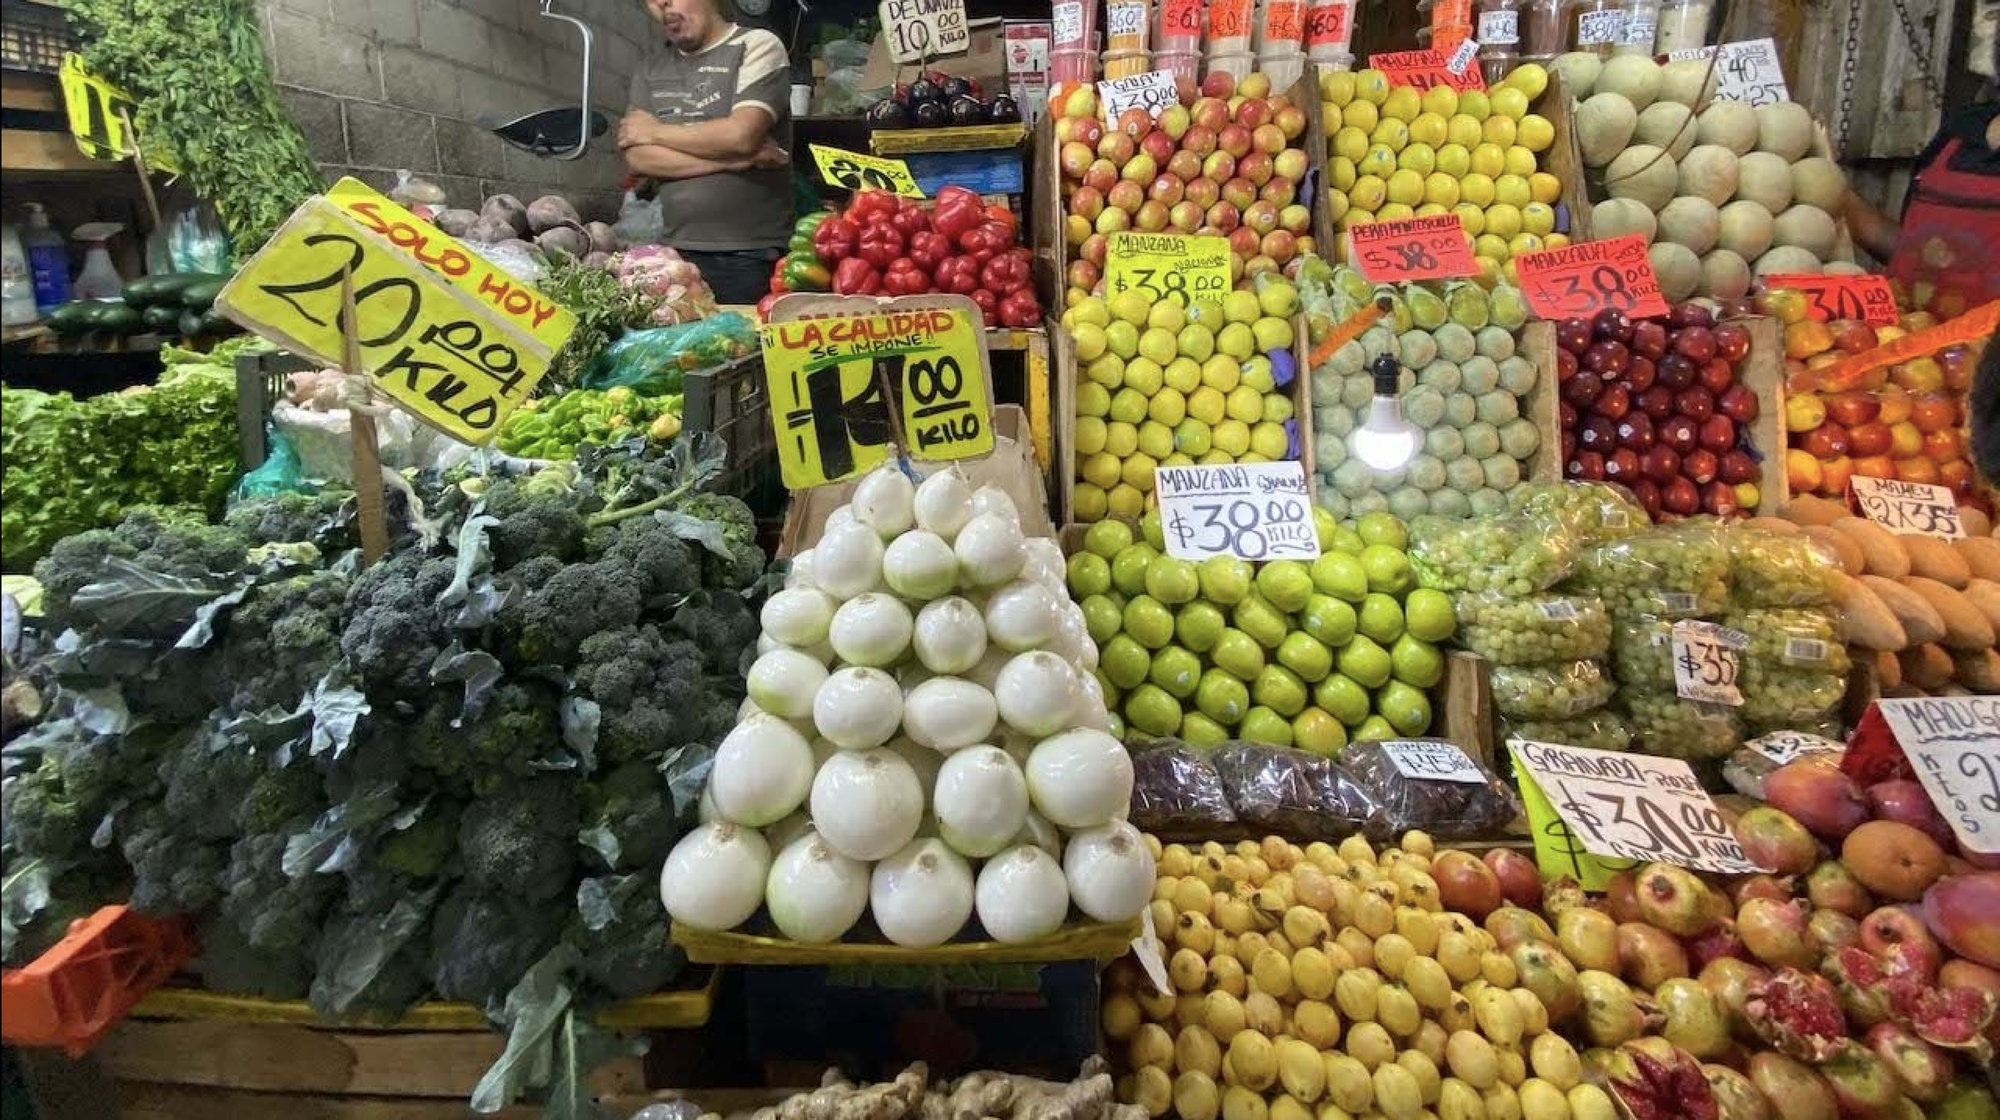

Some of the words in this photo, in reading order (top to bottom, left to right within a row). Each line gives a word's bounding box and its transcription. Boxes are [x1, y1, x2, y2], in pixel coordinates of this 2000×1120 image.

[888, 1, 915, 20] DE
[937, 12, 960, 27] 00
[894, 20, 930, 56] 10
[938, 29, 966, 48] KILO
[1117, 235, 1187, 254] MANZANA
[1523, 243, 1608, 272] MANZANA
[350, 202, 471, 276] SOLO
[477, 273, 557, 329] HOY
[258, 233, 422, 348] 20
[829, 312, 954, 342] CALIDAD
[810, 346, 839, 360] SE
[373, 346, 498, 429] KILO
[908, 355, 962, 405] 00
[916, 413, 980, 452] KILO
[1160, 466, 1251, 492] MANZANA
[1169, 500, 1267, 558] $38
[1265, 523, 1313, 542] KILO
[1678, 641, 1734, 687] $35
[1557, 779, 1702, 859] $30
